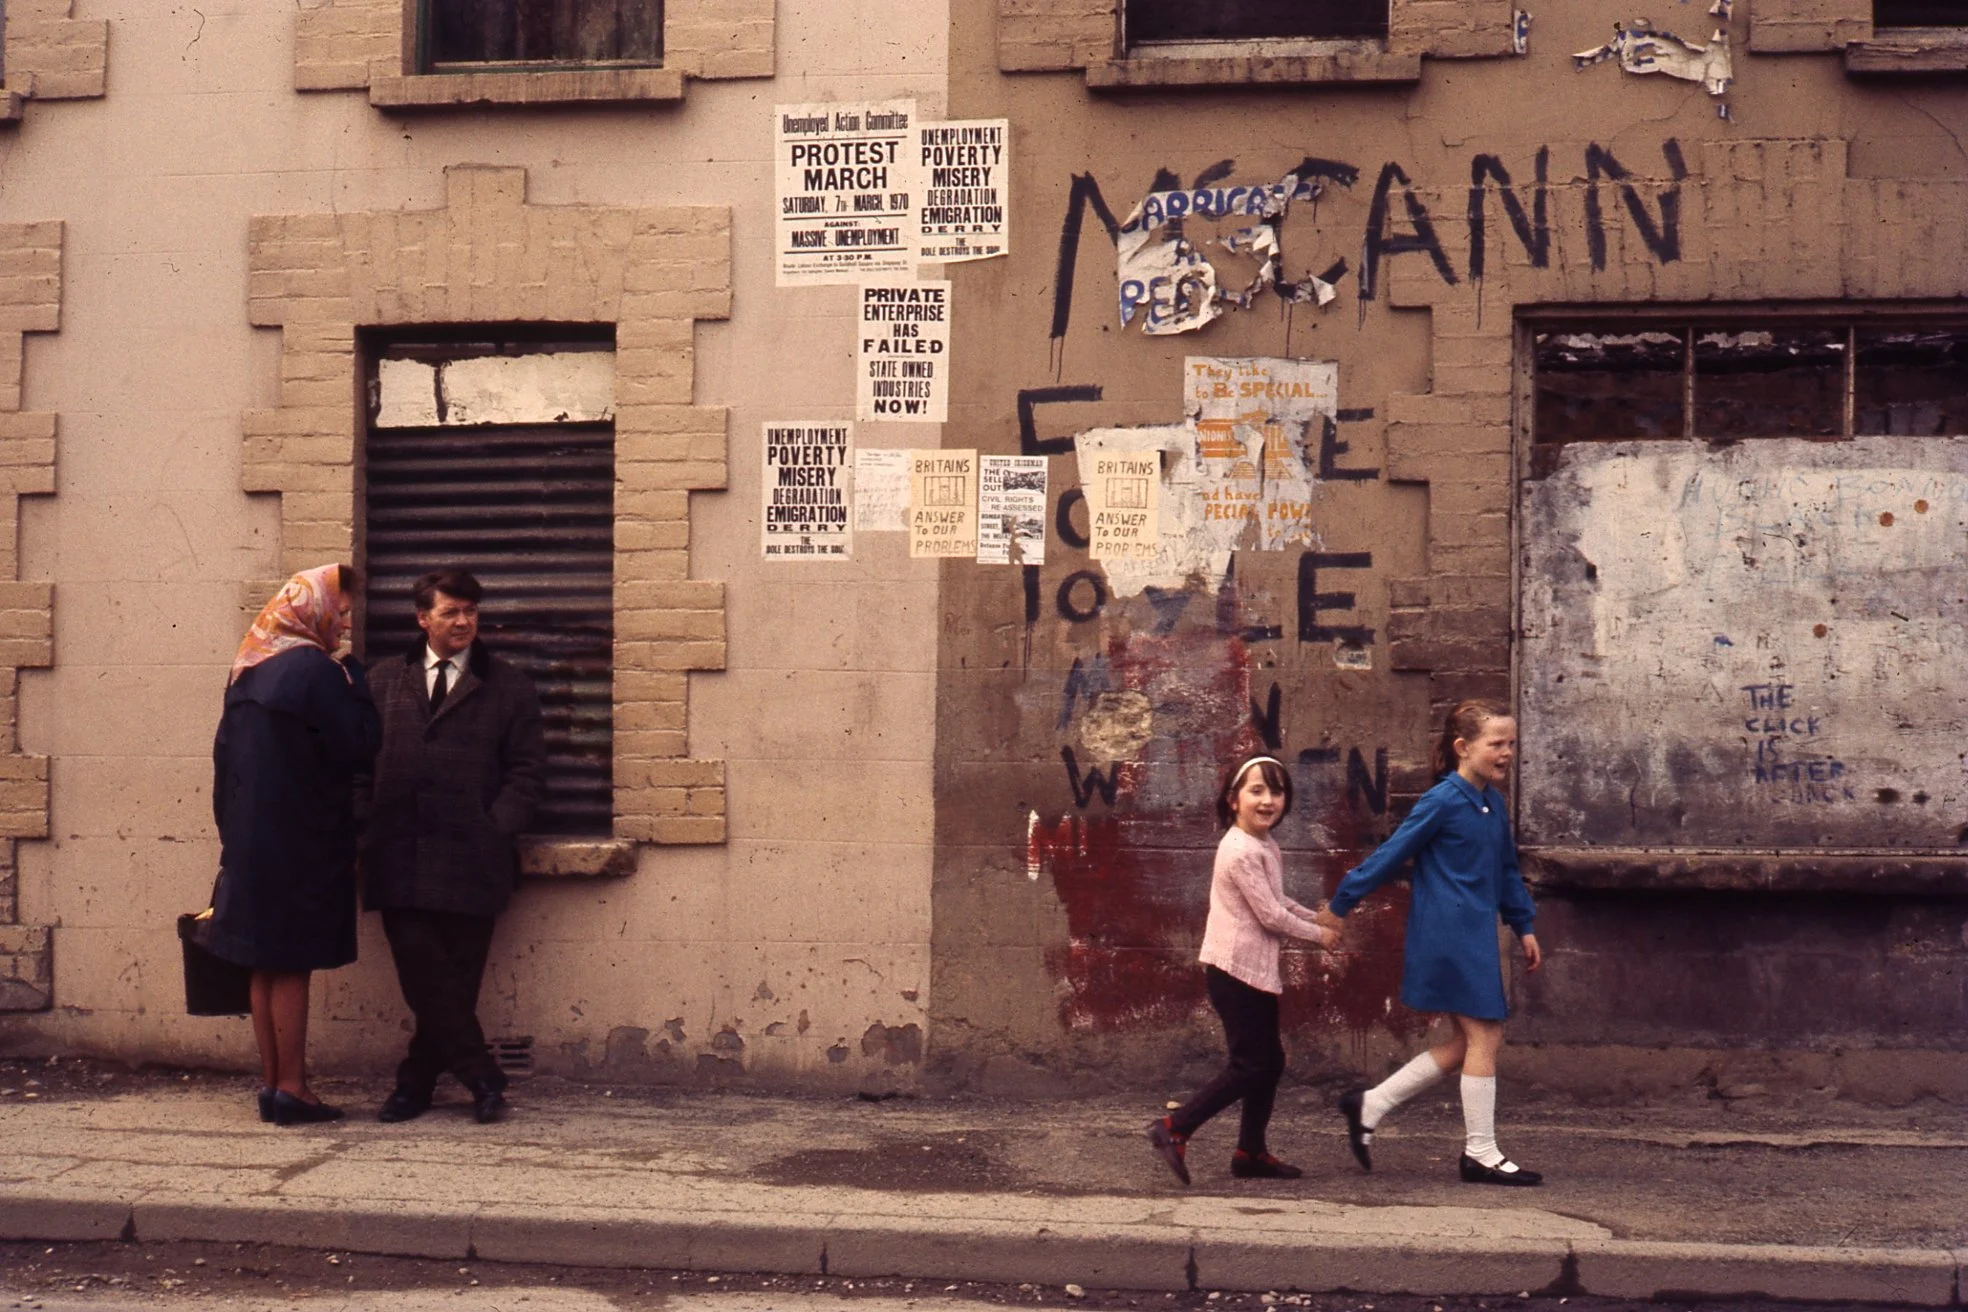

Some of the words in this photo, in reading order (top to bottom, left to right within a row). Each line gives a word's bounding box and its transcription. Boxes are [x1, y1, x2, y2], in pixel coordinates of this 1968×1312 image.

[783, 114, 829, 136] Unemployed
[835, 112, 860, 131] Action
[865, 110, 908, 130] Committee
[921, 127, 1002, 146] UNEMPLOYMENT
[791, 141, 899, 167] PROTEST
[921, 145, 1002, 167] POVERTY
[804, 166, 888, 191] MARCH
[932, 167, 992, 188] MISERY
[889, 193, 909, 210] 1970
[927, 188, 997, 206] DEGRADATION
[921, 206, 1003, 225] EMIGRATION
[791, 230, 828, 248] MASSIVE
[834, 227, 900, 247] UNEMPLOYMENT
[921, 224, 1001, 234] DERRY
[939, 246, 970, 256] DESTROYS
[972, 245, 983, 255] THE
[864, 288, 945, 303] PRIVATE
[864, 304, 945, 321] ENTERPRISE
[893, 323, 919, 338] HAS
[863, 339, 944, 354] FAILED
[869, 361, 898, 378] STATE
[901, 361, 934, 379] OWNED
[1192, 363, 1232, 381] They
[1239, 361, 1269, 376] like
[872, 381, 931, 398] INDUSTRIES
[1195, 384, 1209, 399] to
[873, 400, 928, 415] NOW!
[767, 428, 847, 445] UNEMPLOYMENT
[767, 446, 847, 466] POVERTY
[777, 466, 837, 487] MISERY
[983, 476, 1003, 484] SELL
[984, 468, 1001, 476] THE
[773, 488, 842, 505] DEGRADATION
[982, 484, 1002, 492] OUT
[1224, 485, 1261, 501] have
[981, 495, 1002, 503] CIVIL
[1004, 495, 1035, 504] RIGHTS
[766, 506, 847, 523] EMIGRATION
[914, 511, 966, 524] ANSWER
[1095, 511, 1148, 526] ANSWER
[766, 524, 847, 532] DERRY
[932, 525, 958, 536] OUR
[1113, 526, 1138, 537] OUR
[784, 545, 815, 555] DESTROYS
[817, 545, 829, 554] THE
[915, 540, 977, 555] PROBLEMS
[1740, 684, 1794, 711] THE
[1754, 761, 1845, 783] AFTER
